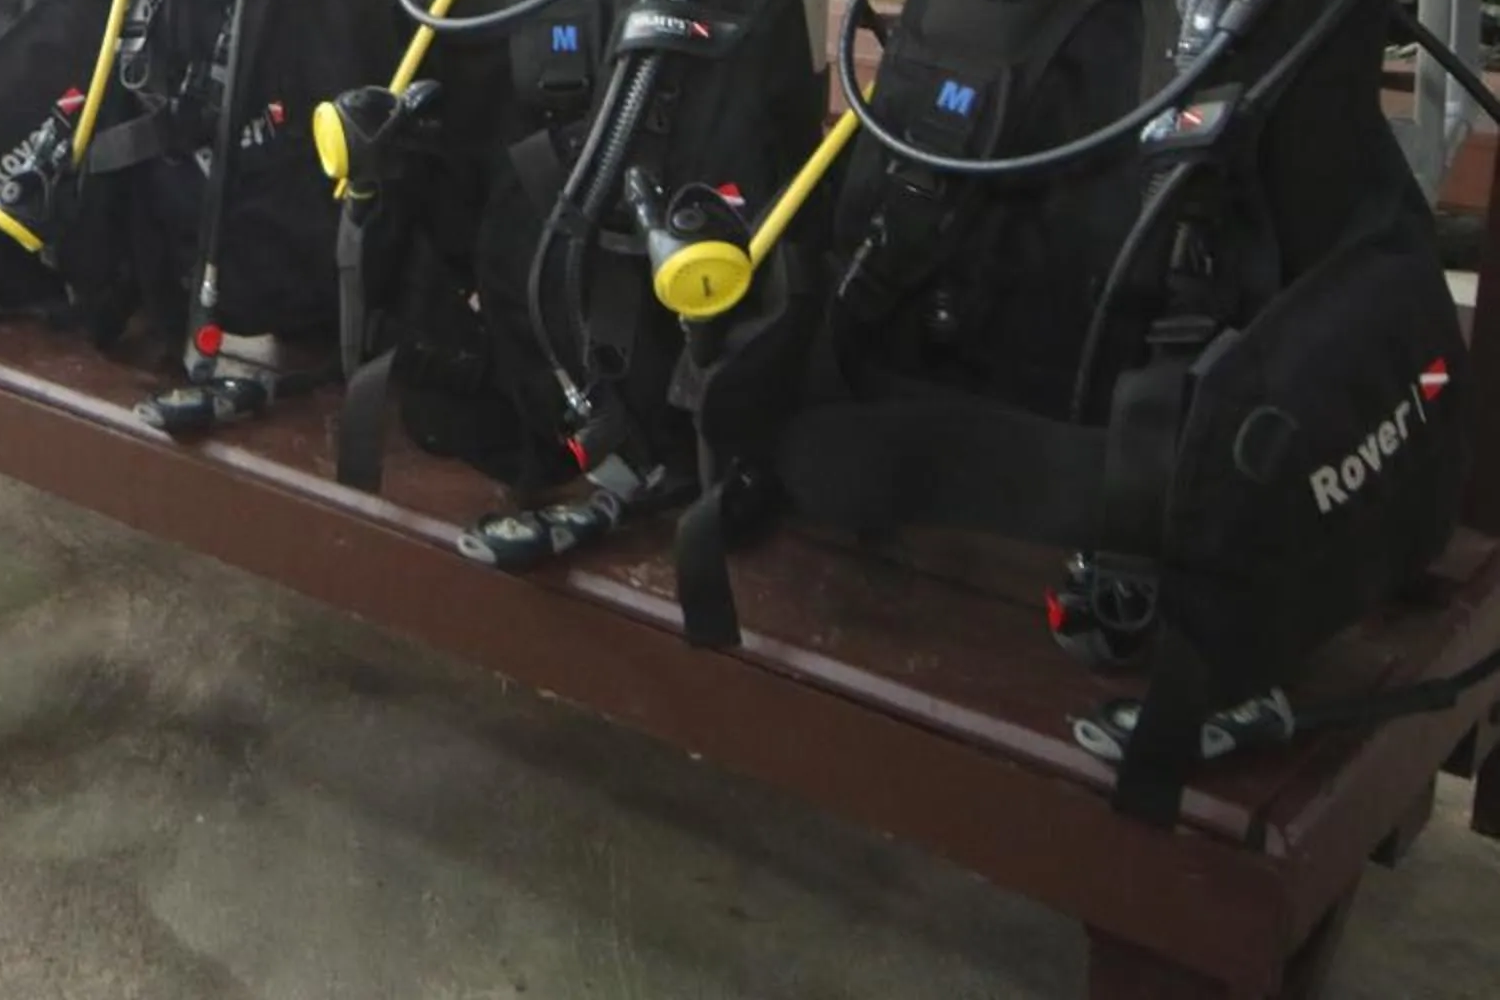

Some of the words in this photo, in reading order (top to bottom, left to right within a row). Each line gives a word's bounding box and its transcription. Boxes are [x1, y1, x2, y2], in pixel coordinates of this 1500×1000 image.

[552, 25, 577, 51] M
[937, 80, 975, 115] M
[1308, 399, 1411, 514] Rover
